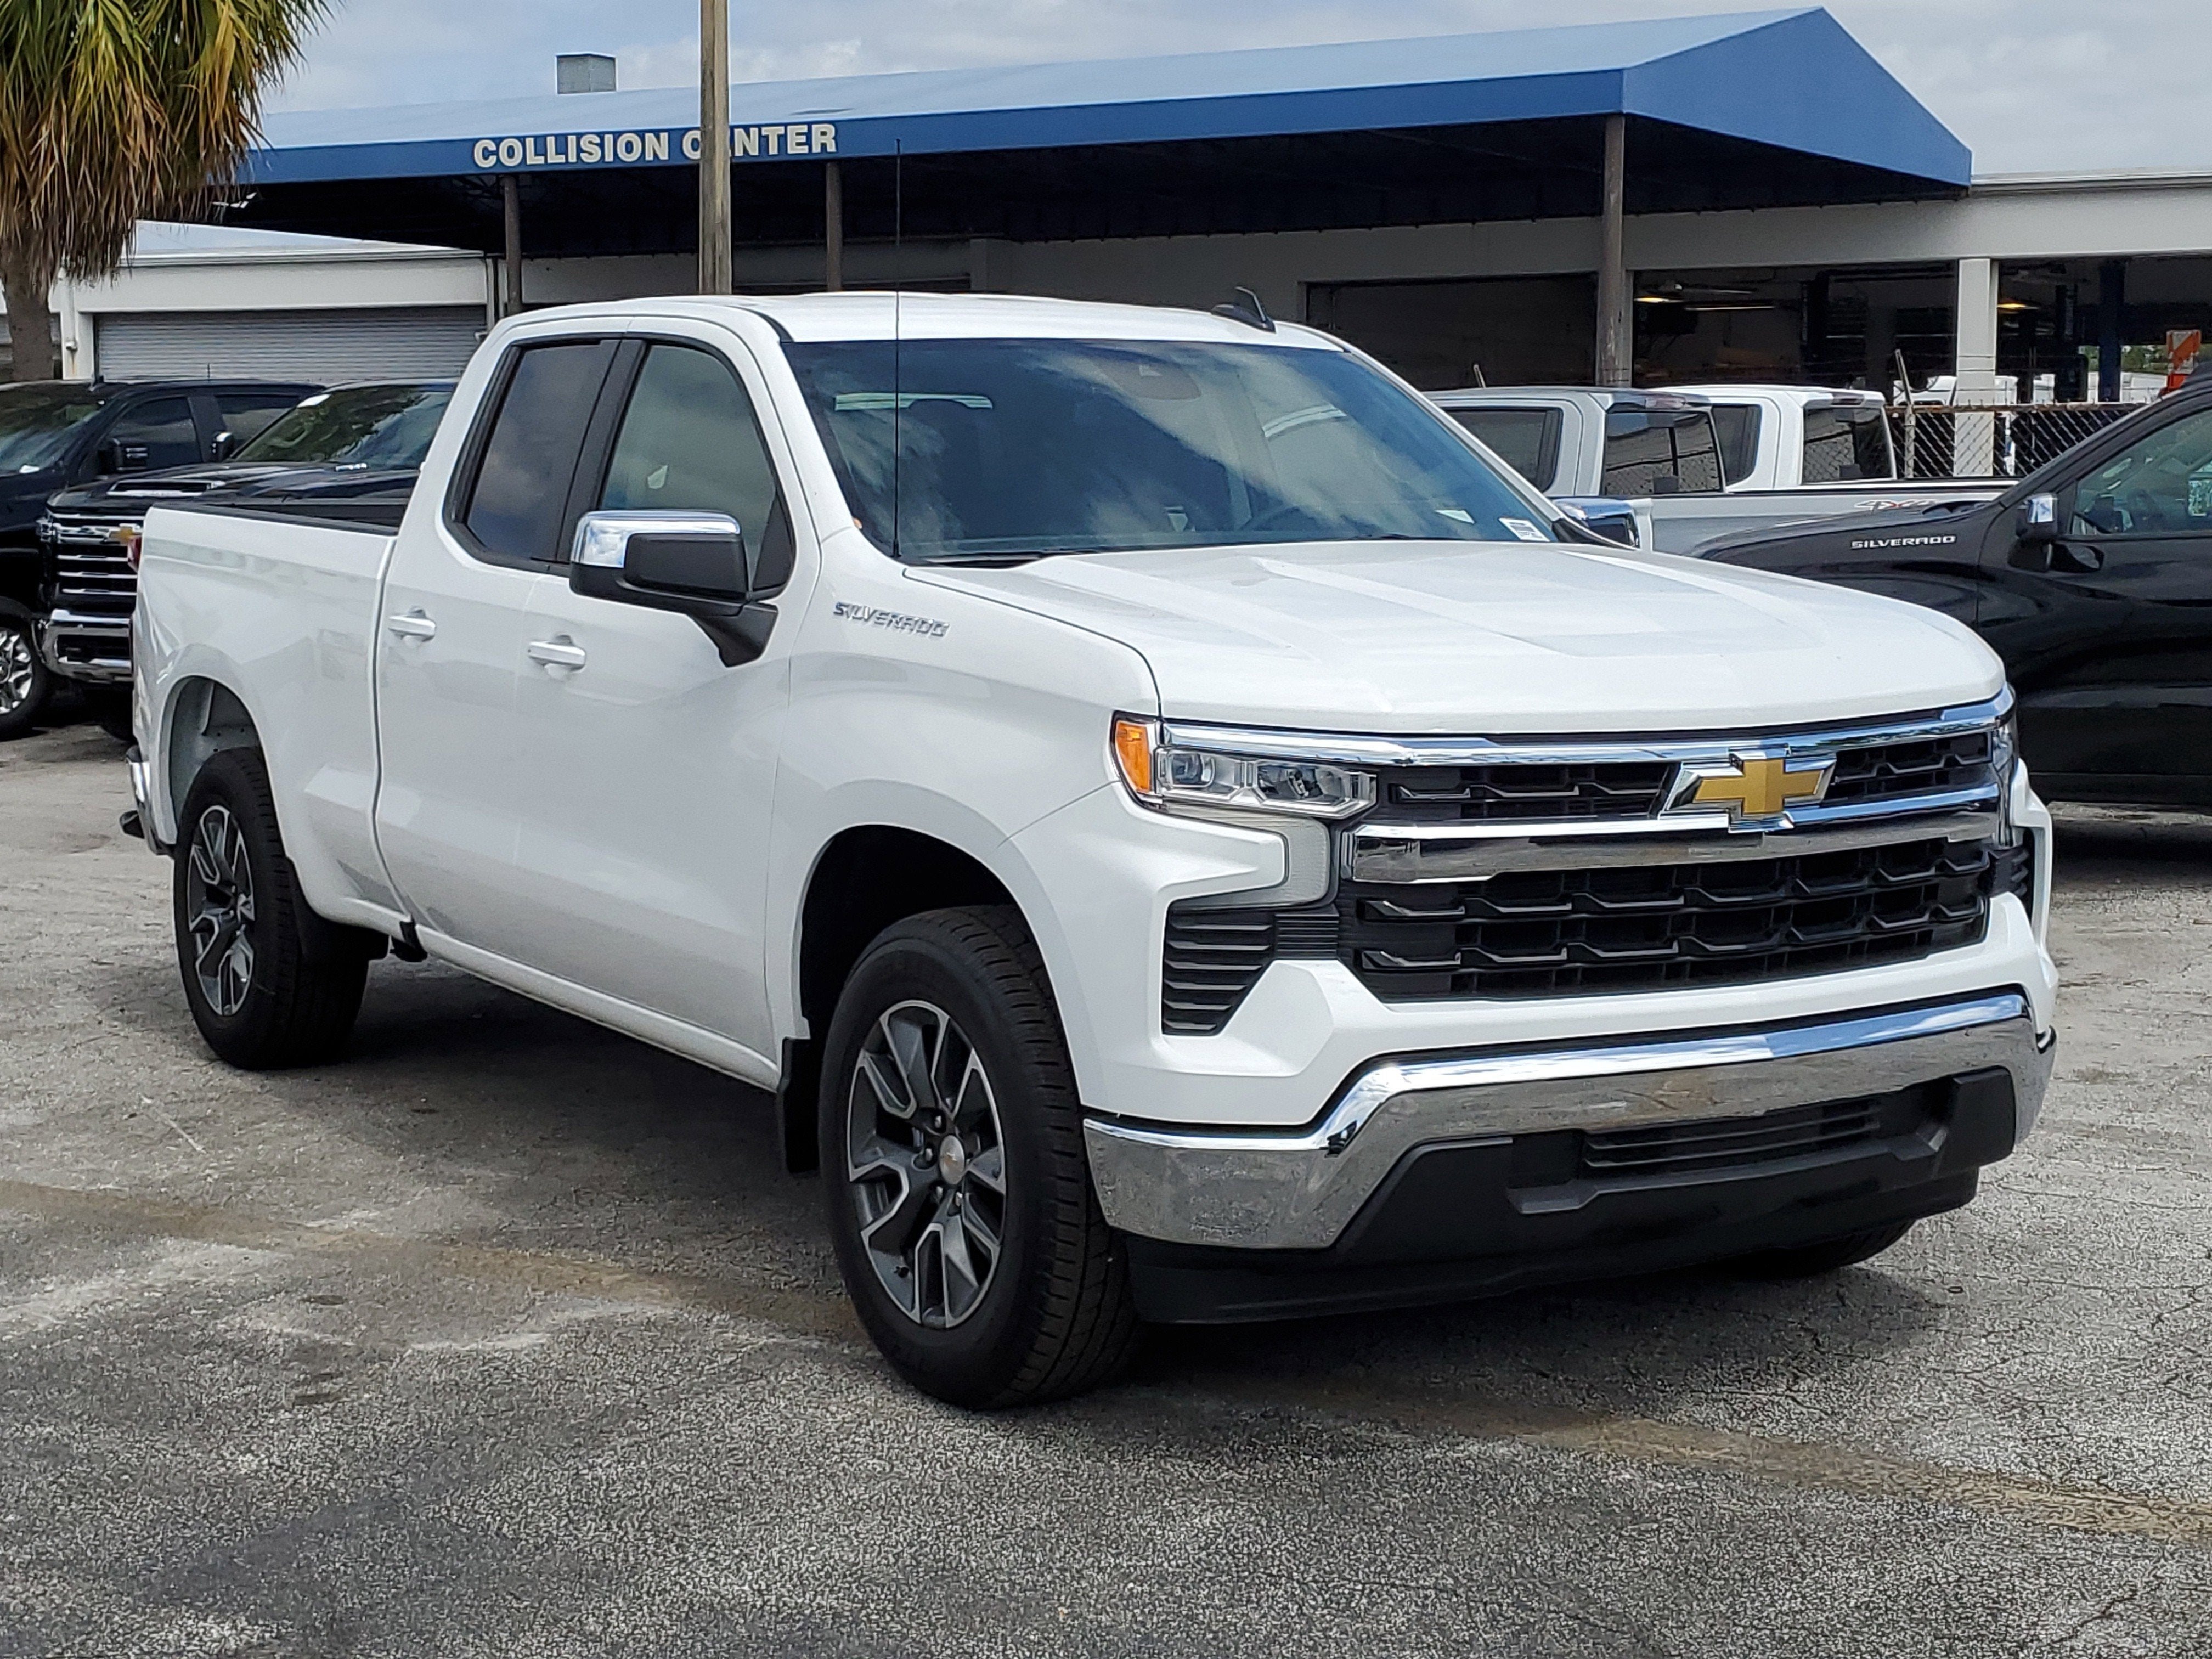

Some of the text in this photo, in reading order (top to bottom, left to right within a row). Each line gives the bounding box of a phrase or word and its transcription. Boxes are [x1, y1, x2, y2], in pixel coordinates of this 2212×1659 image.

[473, 124, 837, 168] COLLISION CNTER
[1852, 535, 1956, 549] SILVERADO
[834, 602, 949, 637] SILVERADO
